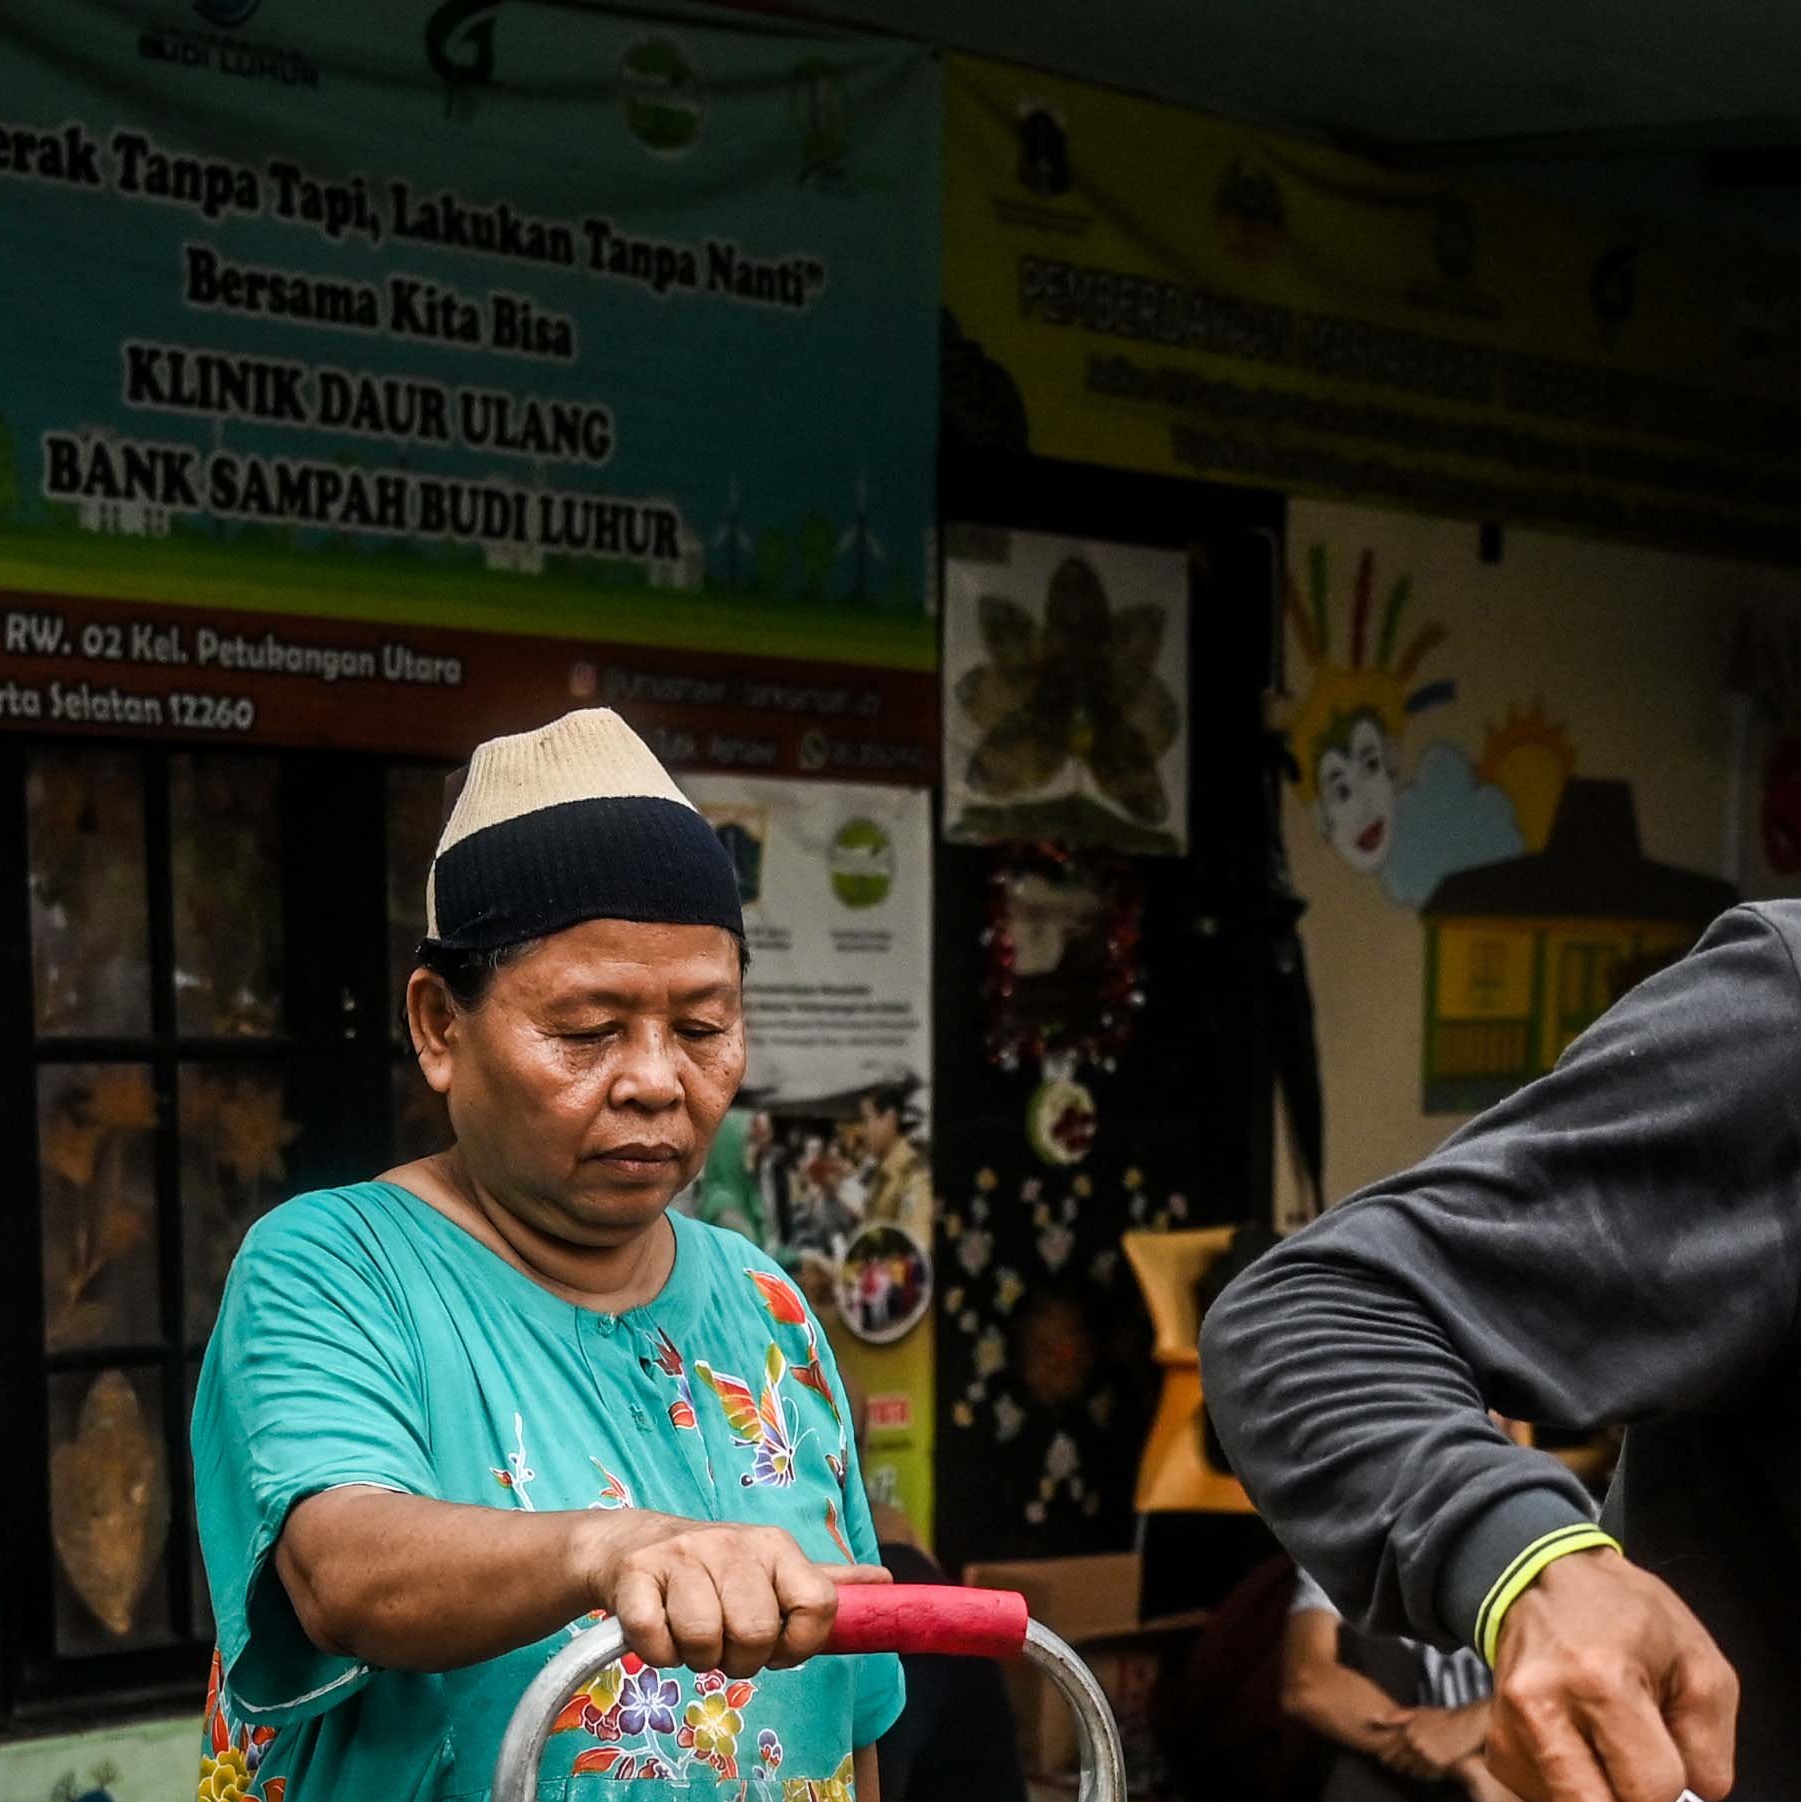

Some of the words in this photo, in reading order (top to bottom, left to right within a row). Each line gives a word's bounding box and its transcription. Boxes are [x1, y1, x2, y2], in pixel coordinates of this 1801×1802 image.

[114, 135, 258, 216] Tanpa
[269, 161, 380, 241] Tapi,
[391, 183, 574, 266] Lakukan
[583, 219, 699, 293] Tanpa
[186, 247, 377, 327] Bersama
[390, 279, 480, 343] Kita
[493, 297, 574, 355] Bisa
[127, 346, 308, 420] KLINIK
[319, 371, 448, 439] DAUR
[461, 391, 613, 461] ULANG
[46, 436, 197, 506] BANK
[210, 456, 407, 529] SAMPAH
[420, 482, 527, 542] BUDI
[540, 496, 681, 560] LUHUR
[5, 612, 73, 658] RW.
[81, 622, 125, 662] 02
[130, 623, 190, 665] Kel.
[198, 628, 376, 682] Petukangan
[382, 641, 463, 686] Utara
[49, 680, 165, 727] Selatan
[169, 692, 256, 732] 12260
